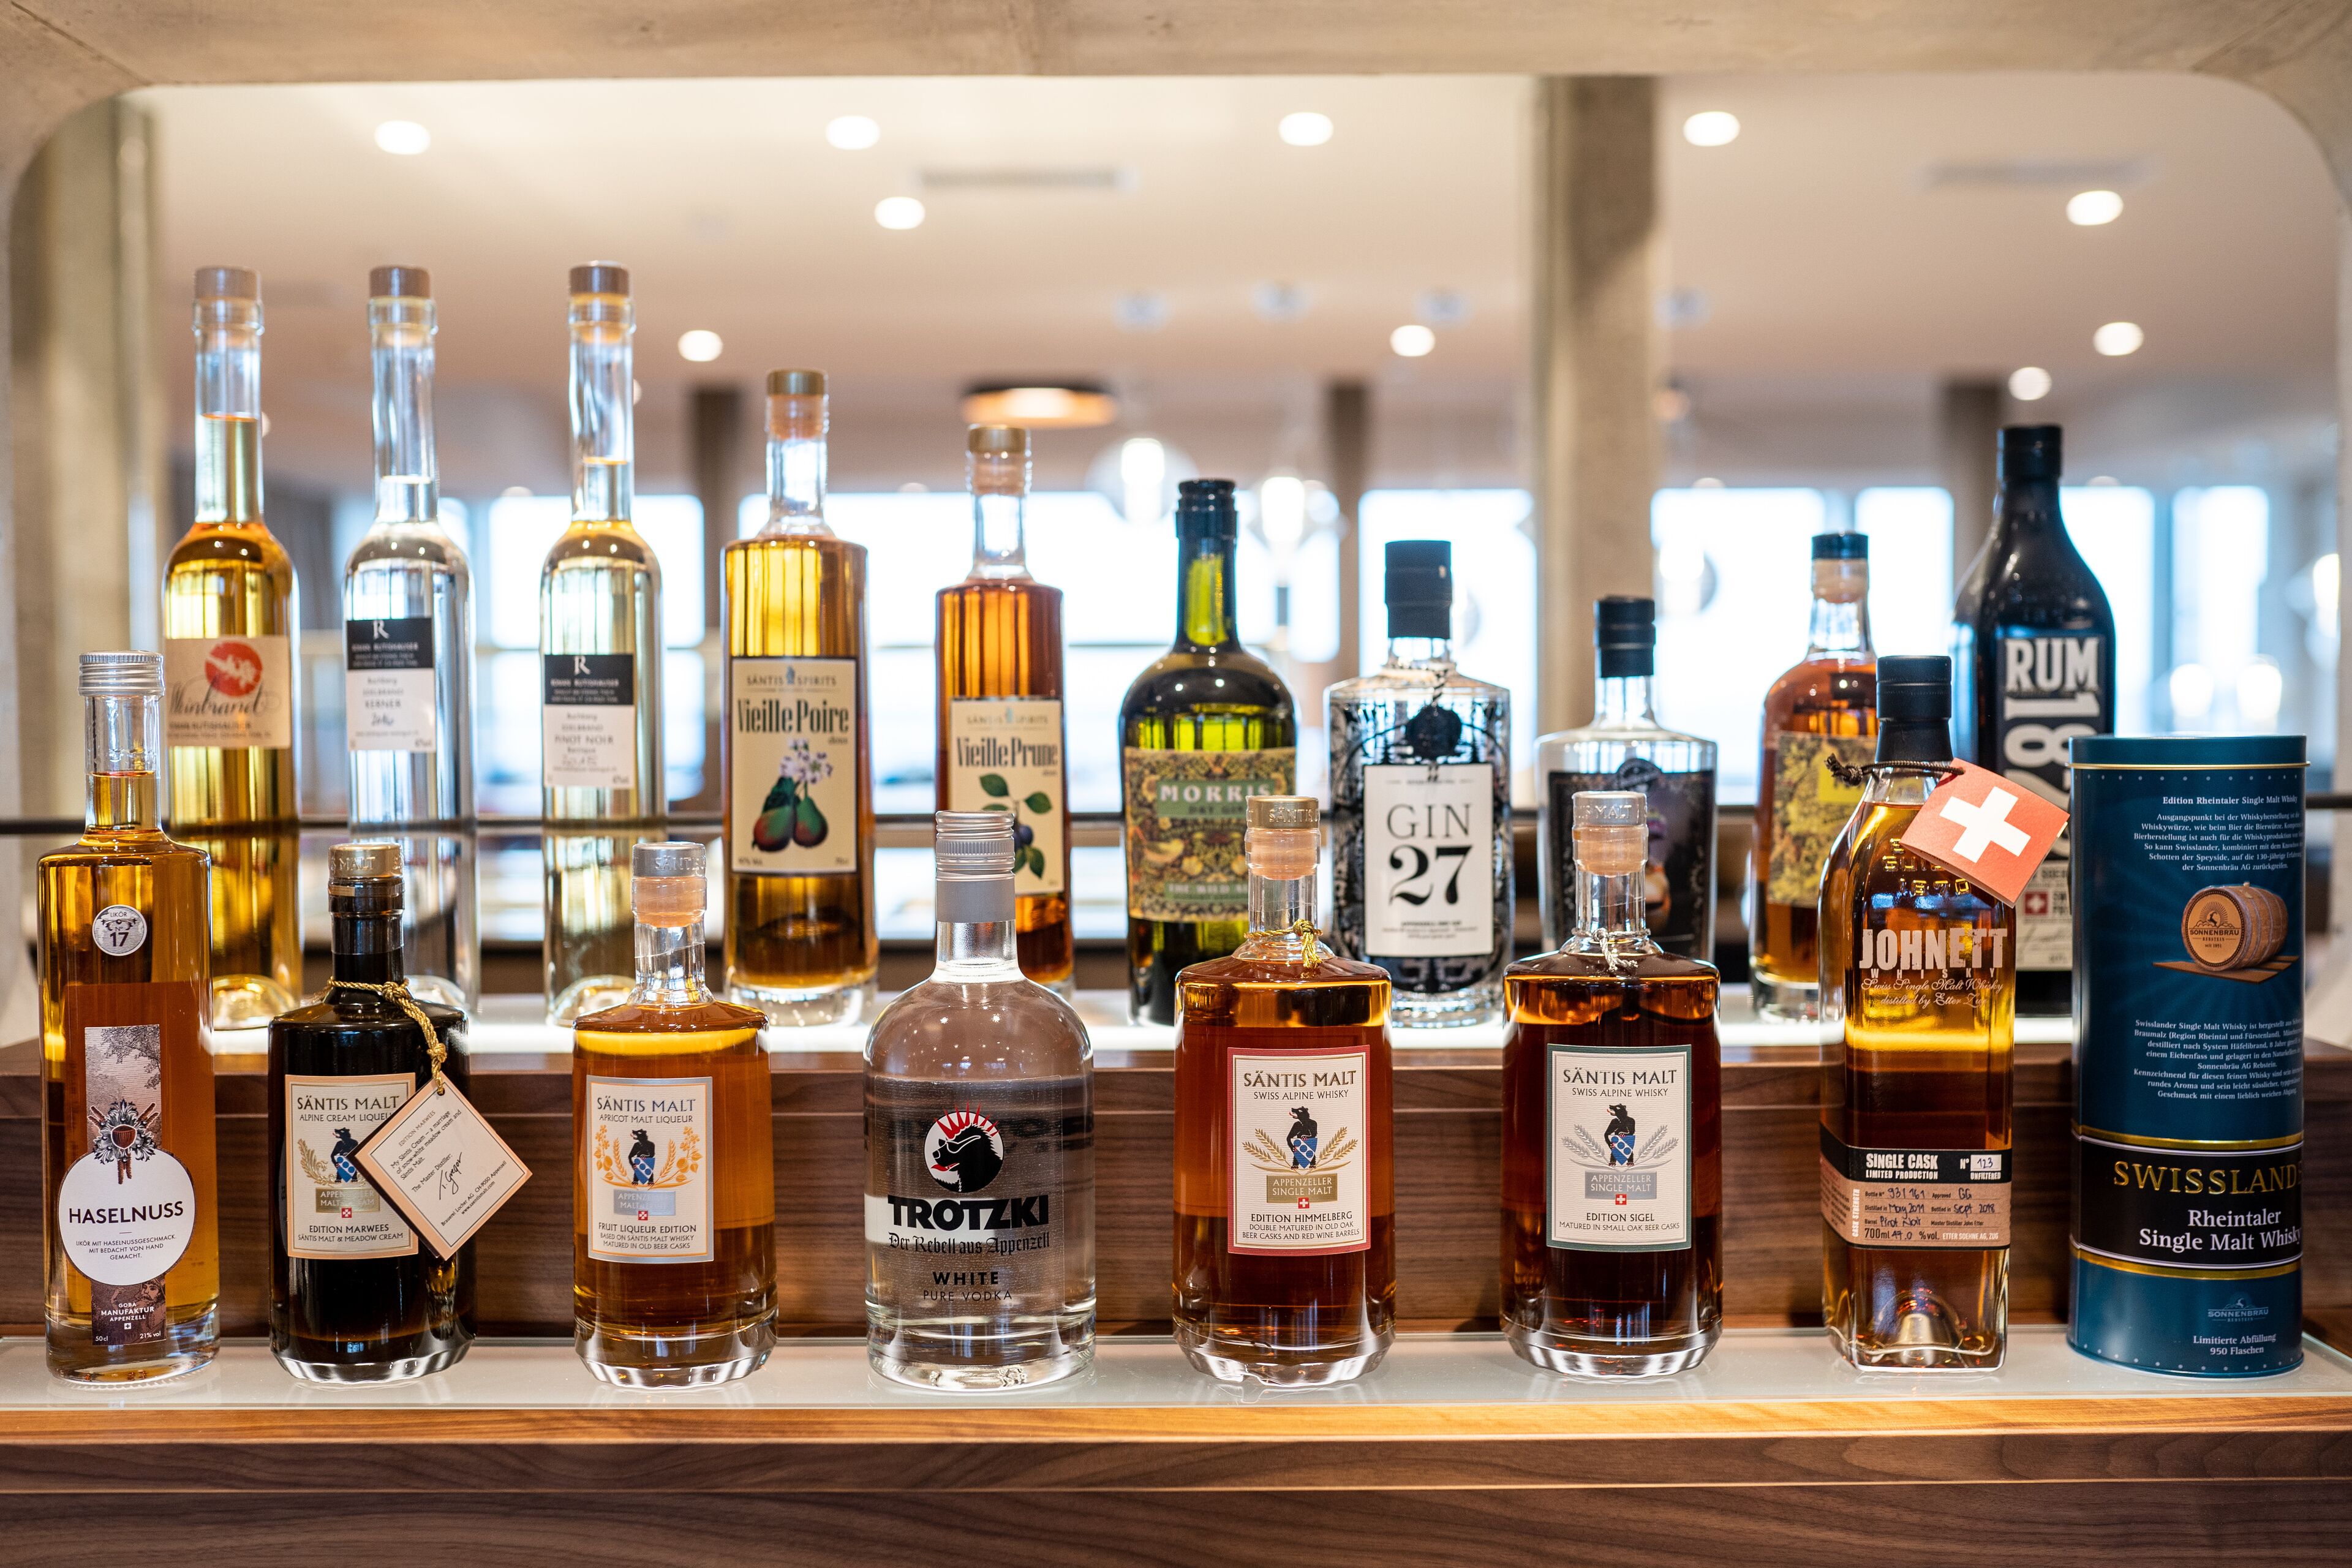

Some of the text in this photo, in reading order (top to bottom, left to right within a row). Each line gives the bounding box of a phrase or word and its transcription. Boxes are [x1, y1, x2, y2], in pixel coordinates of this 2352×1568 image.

[373, 620, 390, 639] R
[574, 655, 591, 674] R
[2004, 637, 2100, 692] RUM
[737, 698, 849, 733] Vieille Poire
[957, 737, 1058, 767] Vieille Prune
[1160, 783, 1271, 802] MORRIS
[2242, 796, 2264, 805] Single
[1387, 803, 1472, 840] GIN
[2157, 813, 2212, 822] Ausgangspunkt
[2134, 833, 2187, 842] Bierherstellung
[1389, 844, 1473, 905] 27
[110, 932, 129, 946] 17
[1859, 928, 2008, 970] JOHNETT
[1861, 978, 2004, 995] Swiss Single Malt Whisky
[1933, 992, 1960, 1006] Etter
[1243, 1070, 1356, 1088] SÄNTIS MALT
[1563, 1067, 1677, 1085] SÄNTIS MALT
[1317, 1089, 1349, 1099] WHISKY
[1572, 1088, 1597, 1096] SWISS
[297, 1095, 399, 1110] SÄNTIS MALT
[597, 1095, 696, 1112] SÄNTIS MALT
[432, 1110, 451, 1129] marriage
[656, 1115, 693, 1124] LIQUEUR
[399, 1110, 436, 1147] EDITION MARWEES
[1866, 1153, 1938, 1169] SINGLE CASK
[1977, 1157, 1993, 1169] 123
[412, 1169, 436, 1193] The Master
[1273, 1177, 1332, 1186] APPENZELLER
[1866, 1169, 1938, 1180] LIMITED PRODUCTION
[1970, 1172, 2001, 1180] UNFILTERED
[441, 1210, 456, 1226] Brauerei
[454, 1199, 469, 1213] Locher
[475, 1175, 491, 1193] CH-9050
[490, 1161, 507, 1178] Appenzell
[1272, 1186, 1332, 1196] SINGLE MALT
[1591, 1183, 1651, 1192] SINGLE MALT
[69, 1200, 183, 1224] HASELNUSS
[888, 1194, 1049, 1231] TROTZKI
[1251, 1210, 1352, 1223] EDITION HIMMELBERG
[1586, 1213, 1654, 1222] EDITION SIGEL
[2187, 1208, 2282, 1228] Rheintaler
[345, 1224, 389, 1233] MARWEES
[598, 1222, 696, 1234] FRUIT LIQUEUR EDITION
[1559, 1221, 1591, 1231] MATURED
[103, 1234, 176, 1246] HASELNUSSGESCHMACK.
[1335, 1229, 1360, 1238] BARRELS
[1864, 1228, 1890, 1239] 700ml
[2139, 1226, 2302, 1254] Single Malt Whisky
[888, 1232, 1050, 1256] Der Rebell aus Appenzell
[932, 1271, 999, 1286] WHITE
[924, 1290, 1012, 1302] PURE VODKA
[101, 1306, 154, 1316] MANUFAKTUR
[2193, 1333, 2277, 1344] Limitierte Abfüllung
[2230, 1346, 2264, 1355] Flaschen
